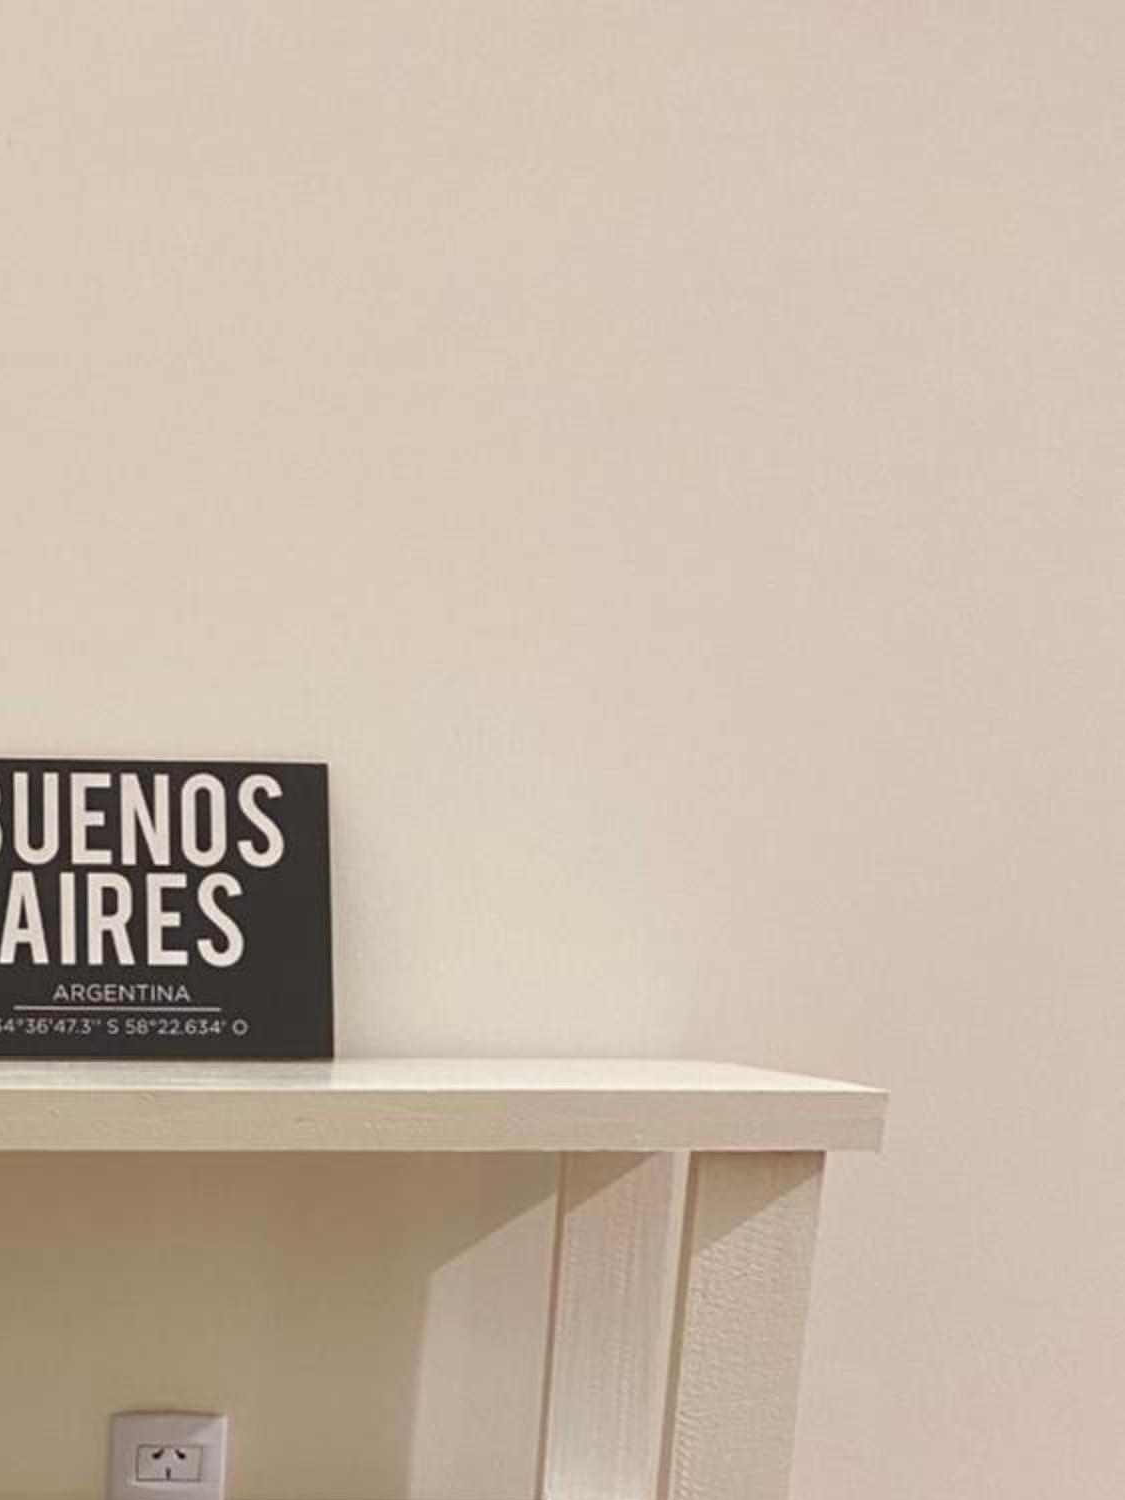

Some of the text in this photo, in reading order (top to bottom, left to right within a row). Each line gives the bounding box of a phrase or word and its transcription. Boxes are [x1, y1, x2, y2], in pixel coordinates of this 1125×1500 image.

[52, 983, 191, 1002] ARGENTINA
[106, 1018, 120, 1035] S
[231, 1018, 249, 1036] O
